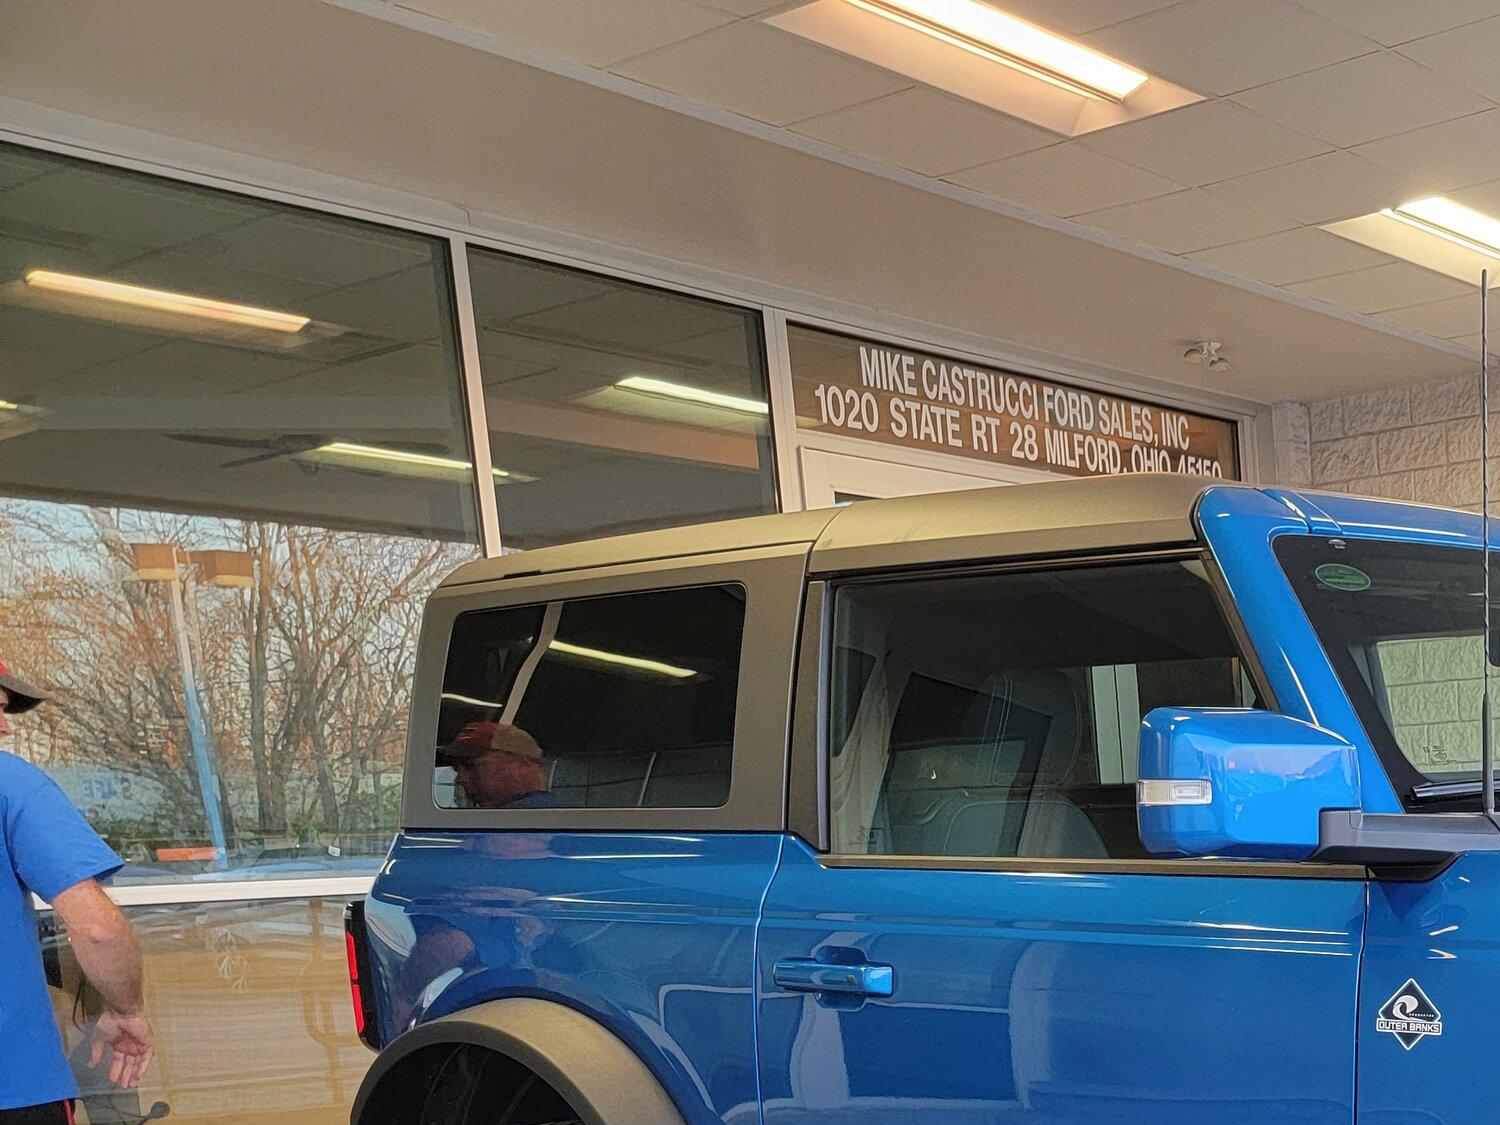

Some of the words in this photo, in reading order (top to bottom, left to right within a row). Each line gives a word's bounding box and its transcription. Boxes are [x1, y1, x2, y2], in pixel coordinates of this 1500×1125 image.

[815, 384, 879, 433] 1020
[889, 397, 963, 448] STATE
[971, 413, 1000, 454] RT
[1009, 421, 1039, 461] 28
[1131, 444, 1171, 473] OHIO
[859, 346, 918, 397] MIKE
[922, 360, 1040, 421] CASTRUCCI
[1042, 385, 1095, 431] FORD
[1098, 399, 1159, 447] SALES,
[1161, 412, 1190, 450] INC
[1379, 1021, 1408, 1031] OUTER
[1409, 1022, 1440, 1033] BANKS
